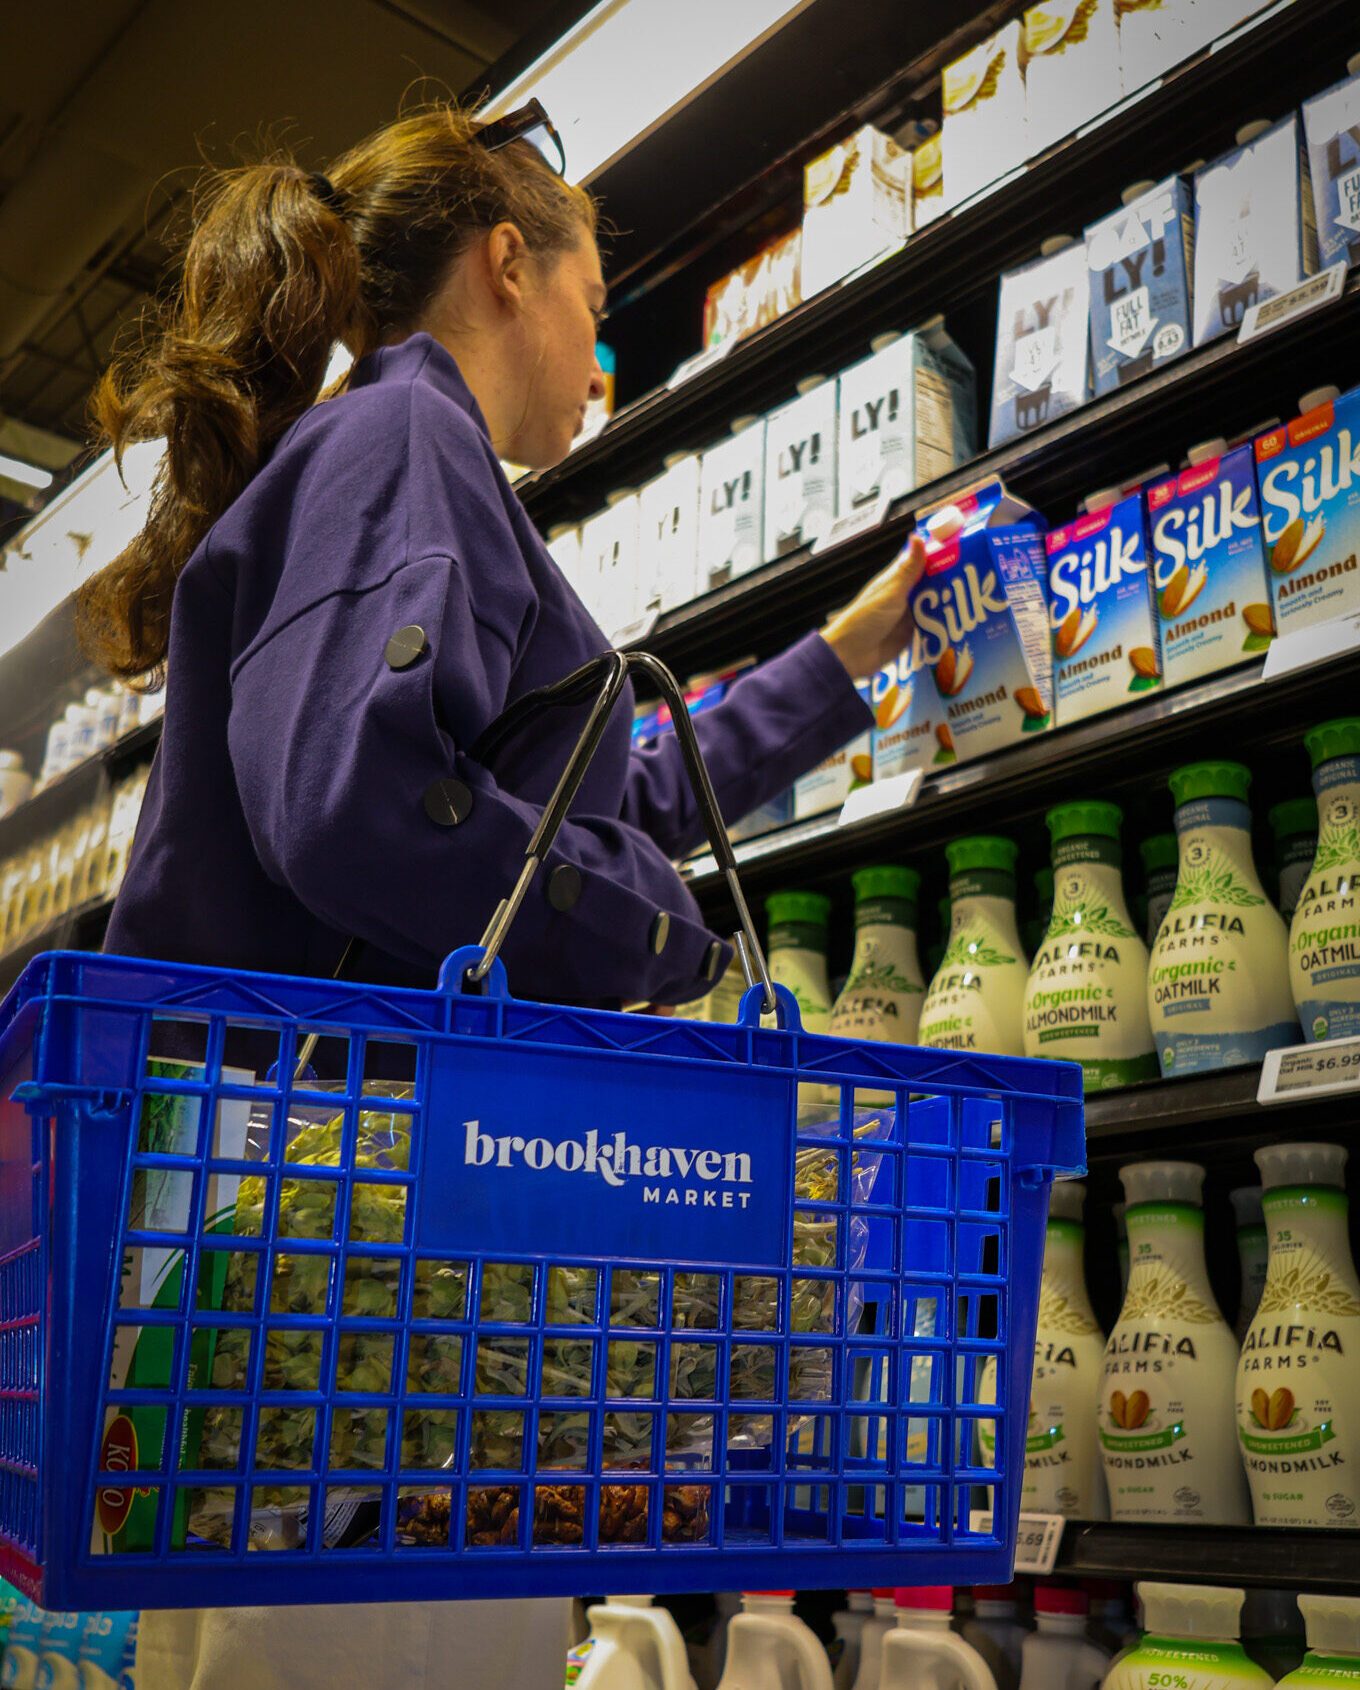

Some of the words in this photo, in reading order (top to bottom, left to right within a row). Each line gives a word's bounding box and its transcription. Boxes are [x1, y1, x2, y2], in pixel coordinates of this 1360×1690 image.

[1103, 238, 1165, 305] LY!
[1115, 297, 1144, 322] FULL
[1119, 313, 1140, 337] FAT
[852, 388, 899, 442] LY!
[777, 433, 821, 490] LY!
[711, 470, 752, 516] LY!
[656, 506, 681, 541] Y!
[1154, 481, 1261, 588] Silk
[1050, 526, 1147, 628] Silk
[1278, 554, 1358, 601] Almond
[913, 563, 1008, 665] Silk
[1165, 602, 1236, 643] Almond
[1058, 645, 1123, 683] Almond
[947, 686, 1007, 721] Almond
[877, 720, 931, 751] Almond
[1335, 805, 1348, 819] 3
[1191, 848, 1202, 860] 3
[1159, 935, 1220, 953] FARMS
[1152, 956, 1225, 985] Organic
[1032, 983, 1103, 1009] Organic
[1155, 977, 1221, 1003] OATMILK
[1026, 1005, 1117, 1032] ALMONDMILK
[1315, 1053, 1360, 1072] $6.99
[462, 1120, 753, 1186] brookhaven
[643, 1186, 752, 1209] MARKET
[1137, 1243, 1152, 1254] 35
[1276, 1230, 1292, 1242] 35
[1105, 1360, 1163, 1376] FARMS
[1244, 1354, 1308, 1372] FARMS
[102, 1443, 131, 1508] KOO
[1148, 1672, 1188, 1690] 50%
